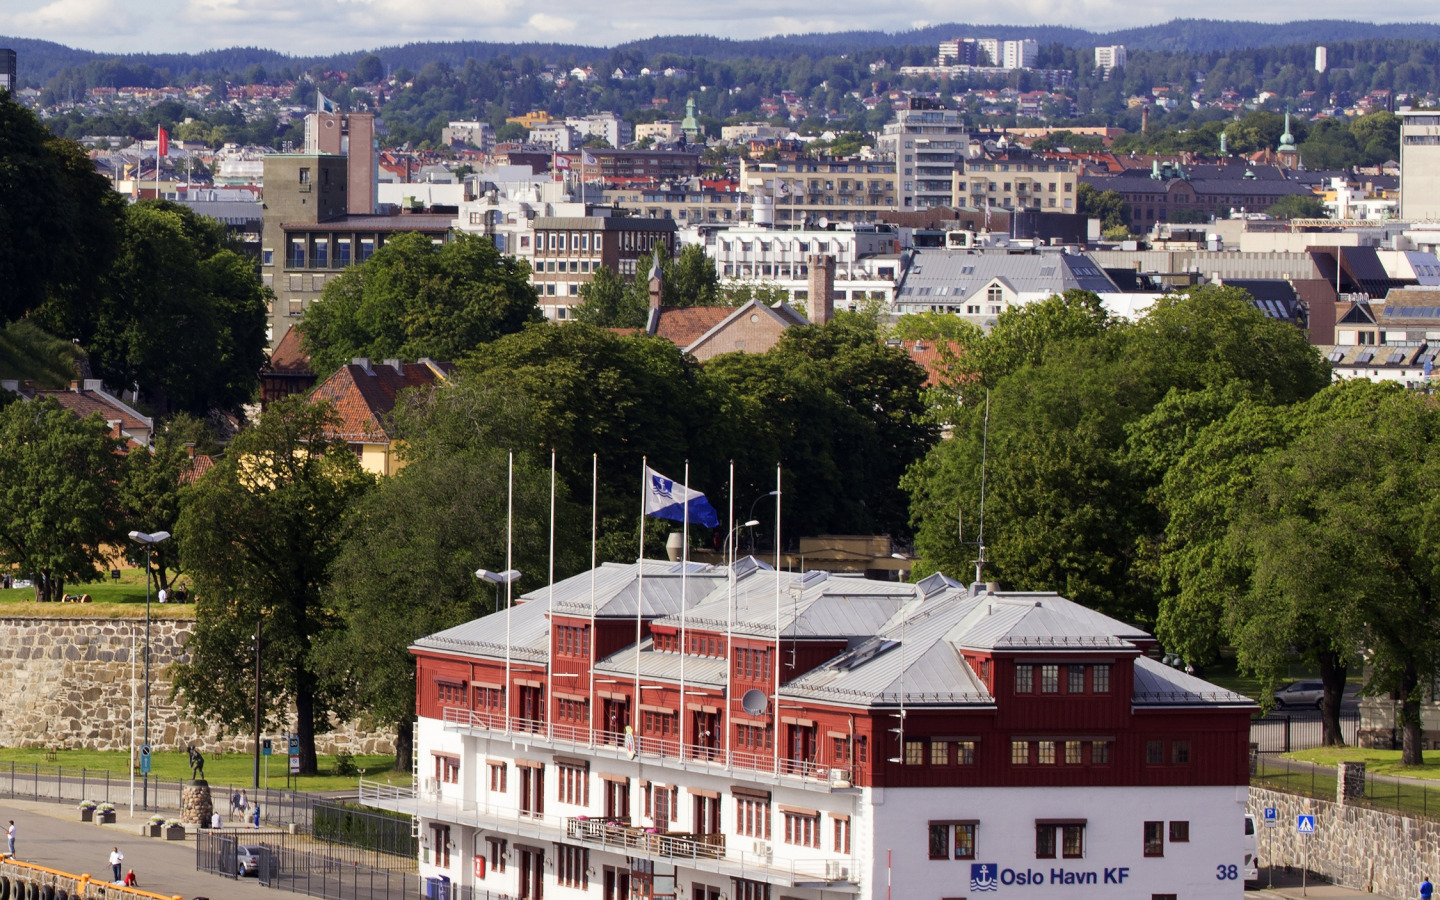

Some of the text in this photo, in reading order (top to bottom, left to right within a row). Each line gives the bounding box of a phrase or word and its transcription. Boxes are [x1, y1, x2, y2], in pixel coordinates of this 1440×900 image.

[1266, 809, 1273, 818] P
[1000, 867, 1130, 886] Oslo Havn KF
[1216, 864, 1239, 881] 38
